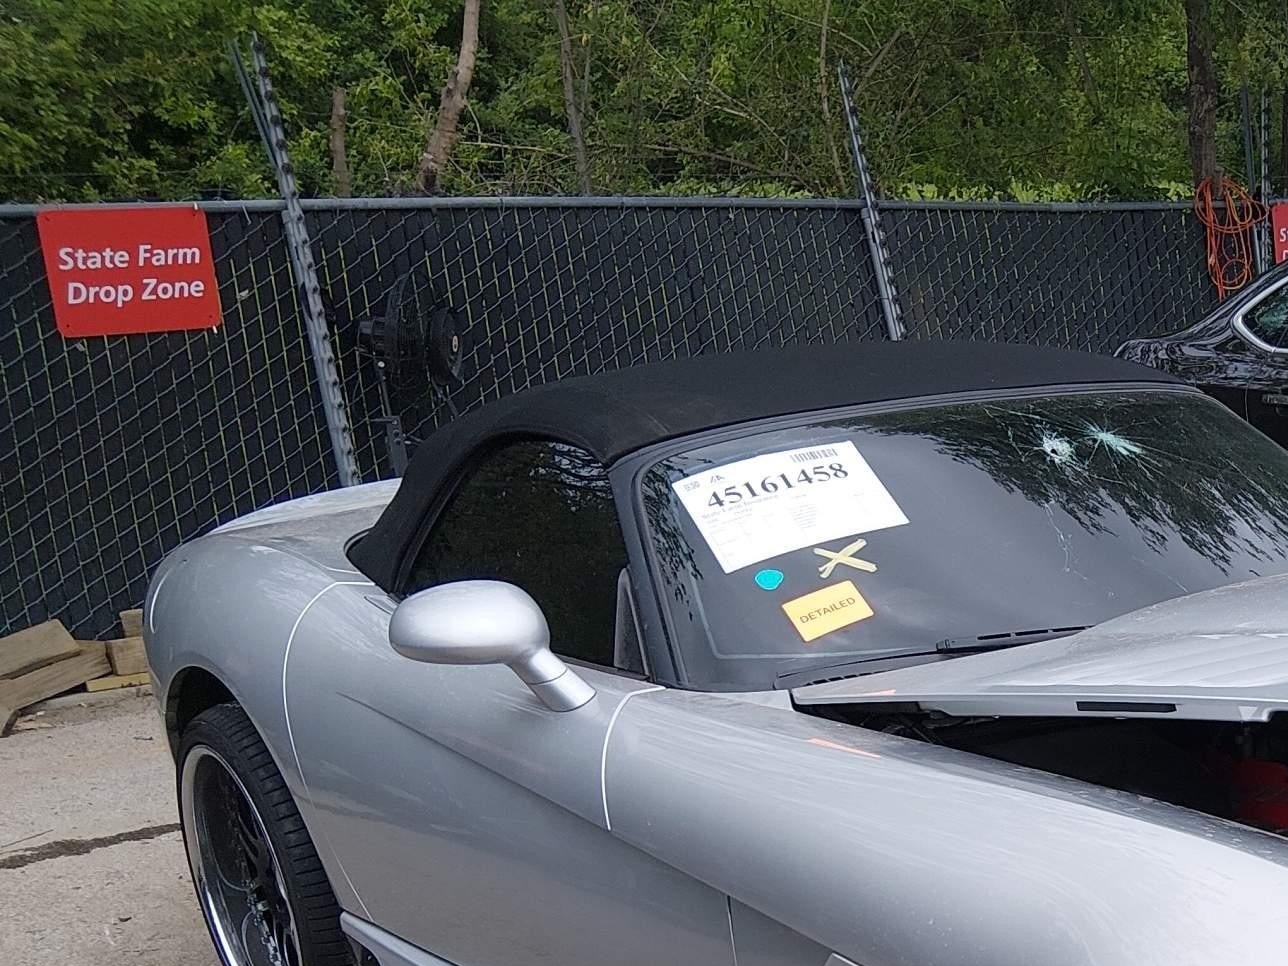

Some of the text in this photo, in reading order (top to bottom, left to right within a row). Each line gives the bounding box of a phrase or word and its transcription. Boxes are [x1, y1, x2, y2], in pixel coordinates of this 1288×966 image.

[58, 244, 201, 271] State Farm
[67, 278, 205, 308] Drop Zone
[706, 462, 849, 508] 45161458
[799, 597, 856, 624] DETAILED
